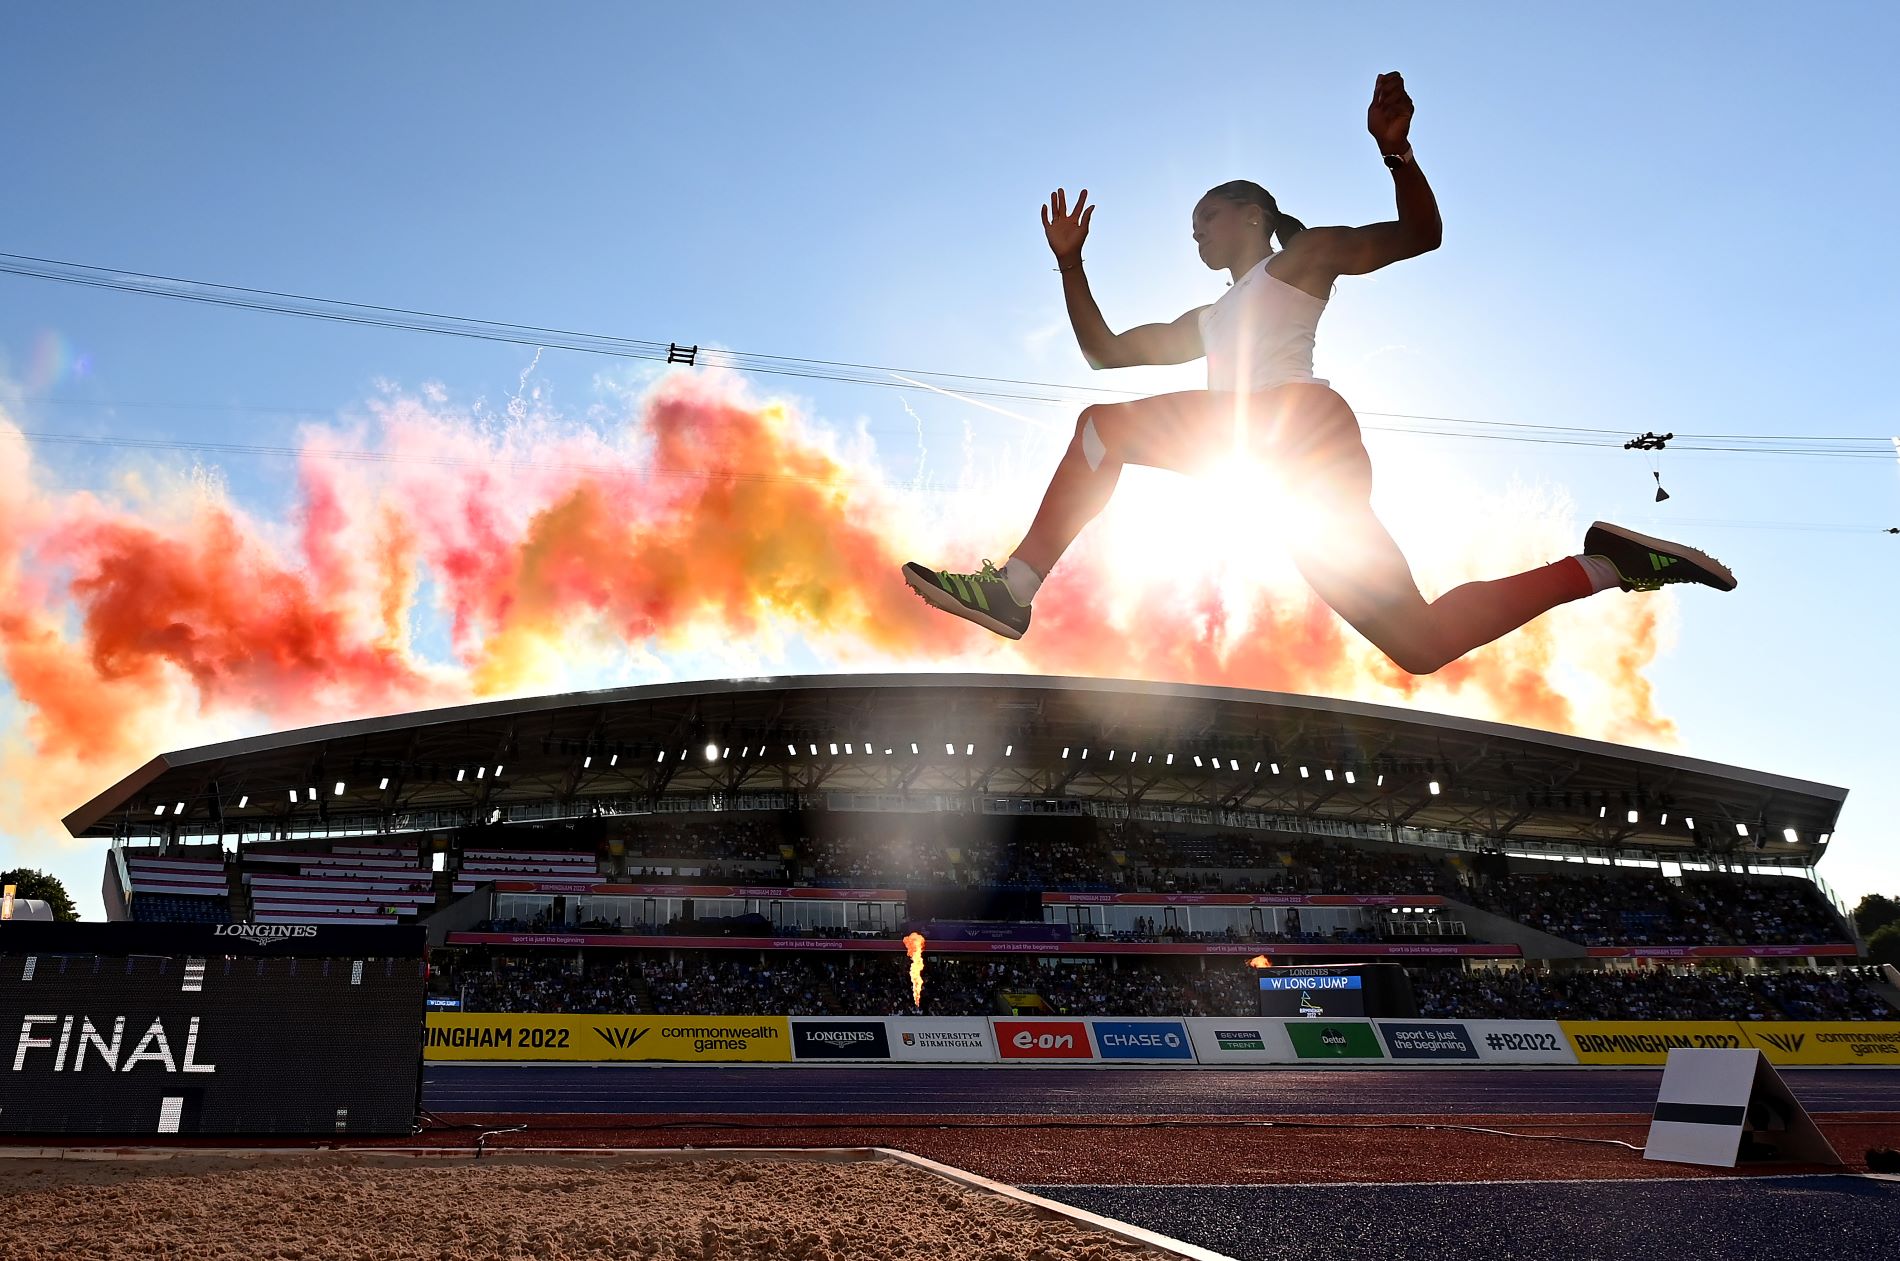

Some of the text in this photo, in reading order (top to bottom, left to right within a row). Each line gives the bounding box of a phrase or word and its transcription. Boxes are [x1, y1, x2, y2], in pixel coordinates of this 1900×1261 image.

[214, 924, 317, 937] LONGINES
[1270, 977, 1348, 989] W LONG JUMP
[518, 1028, 570, 1048] 2022
[661, 1026, 779, 1039] commonwealth
[806, 1032, 875, 1041] LONGINES
[1396, 1030, 1456, 1041] sport is just
[1816, 1032, 1900, 1042] commonwea
[12, 1014, 216, 1073] FINAL
[694, 1038, 747, 1052] games
[1103, 1034, 1162, 1046] CHASE
[1322, 1035, 1346, 1044] Dettol
[1394, 1040, 1467, 1052] the beginning
[1485, 1033, 1562, 1050] #B2022
[1574, 1034, 1740, 1052] BIRMINGHAM 2022
[1850, 1043, 1899, 1056] games
